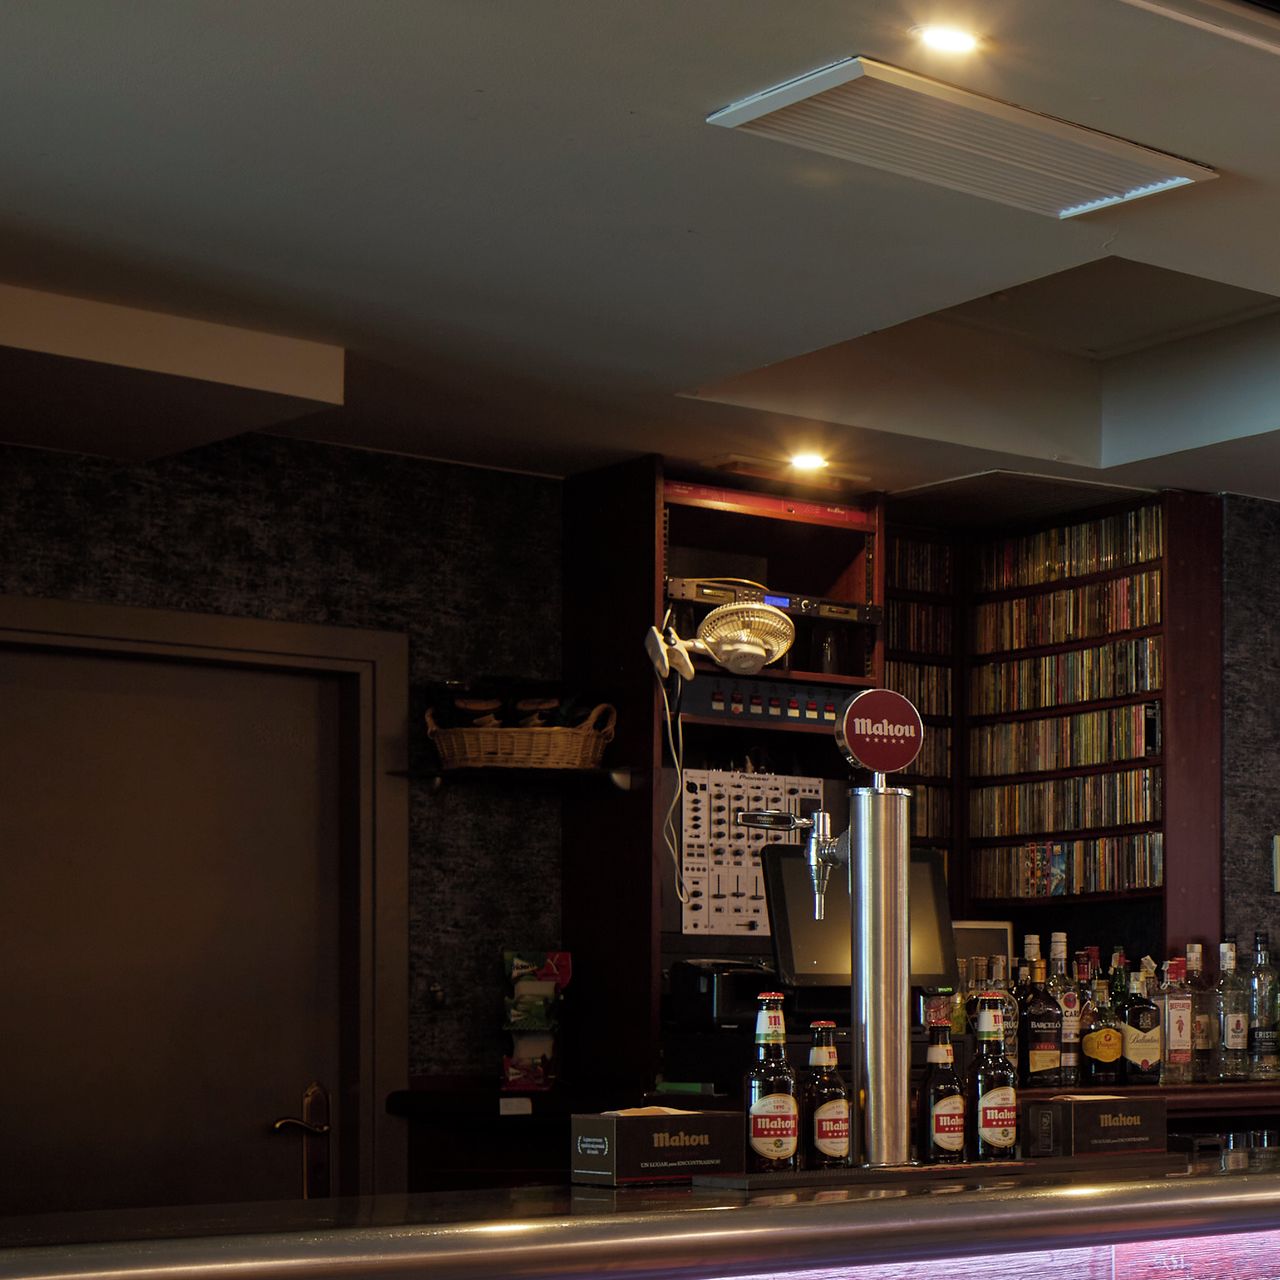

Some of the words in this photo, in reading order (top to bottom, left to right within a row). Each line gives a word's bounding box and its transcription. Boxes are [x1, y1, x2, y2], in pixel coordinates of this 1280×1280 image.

[854, 718, 915, 737] Mahou
[739, 774, 770, 782] Pioneer
[757, 1117, 796, 1129] Mahou
[1099, 1113, 1142, 1128] Mahou
[652, 1131, 711, 1148] Mahou
